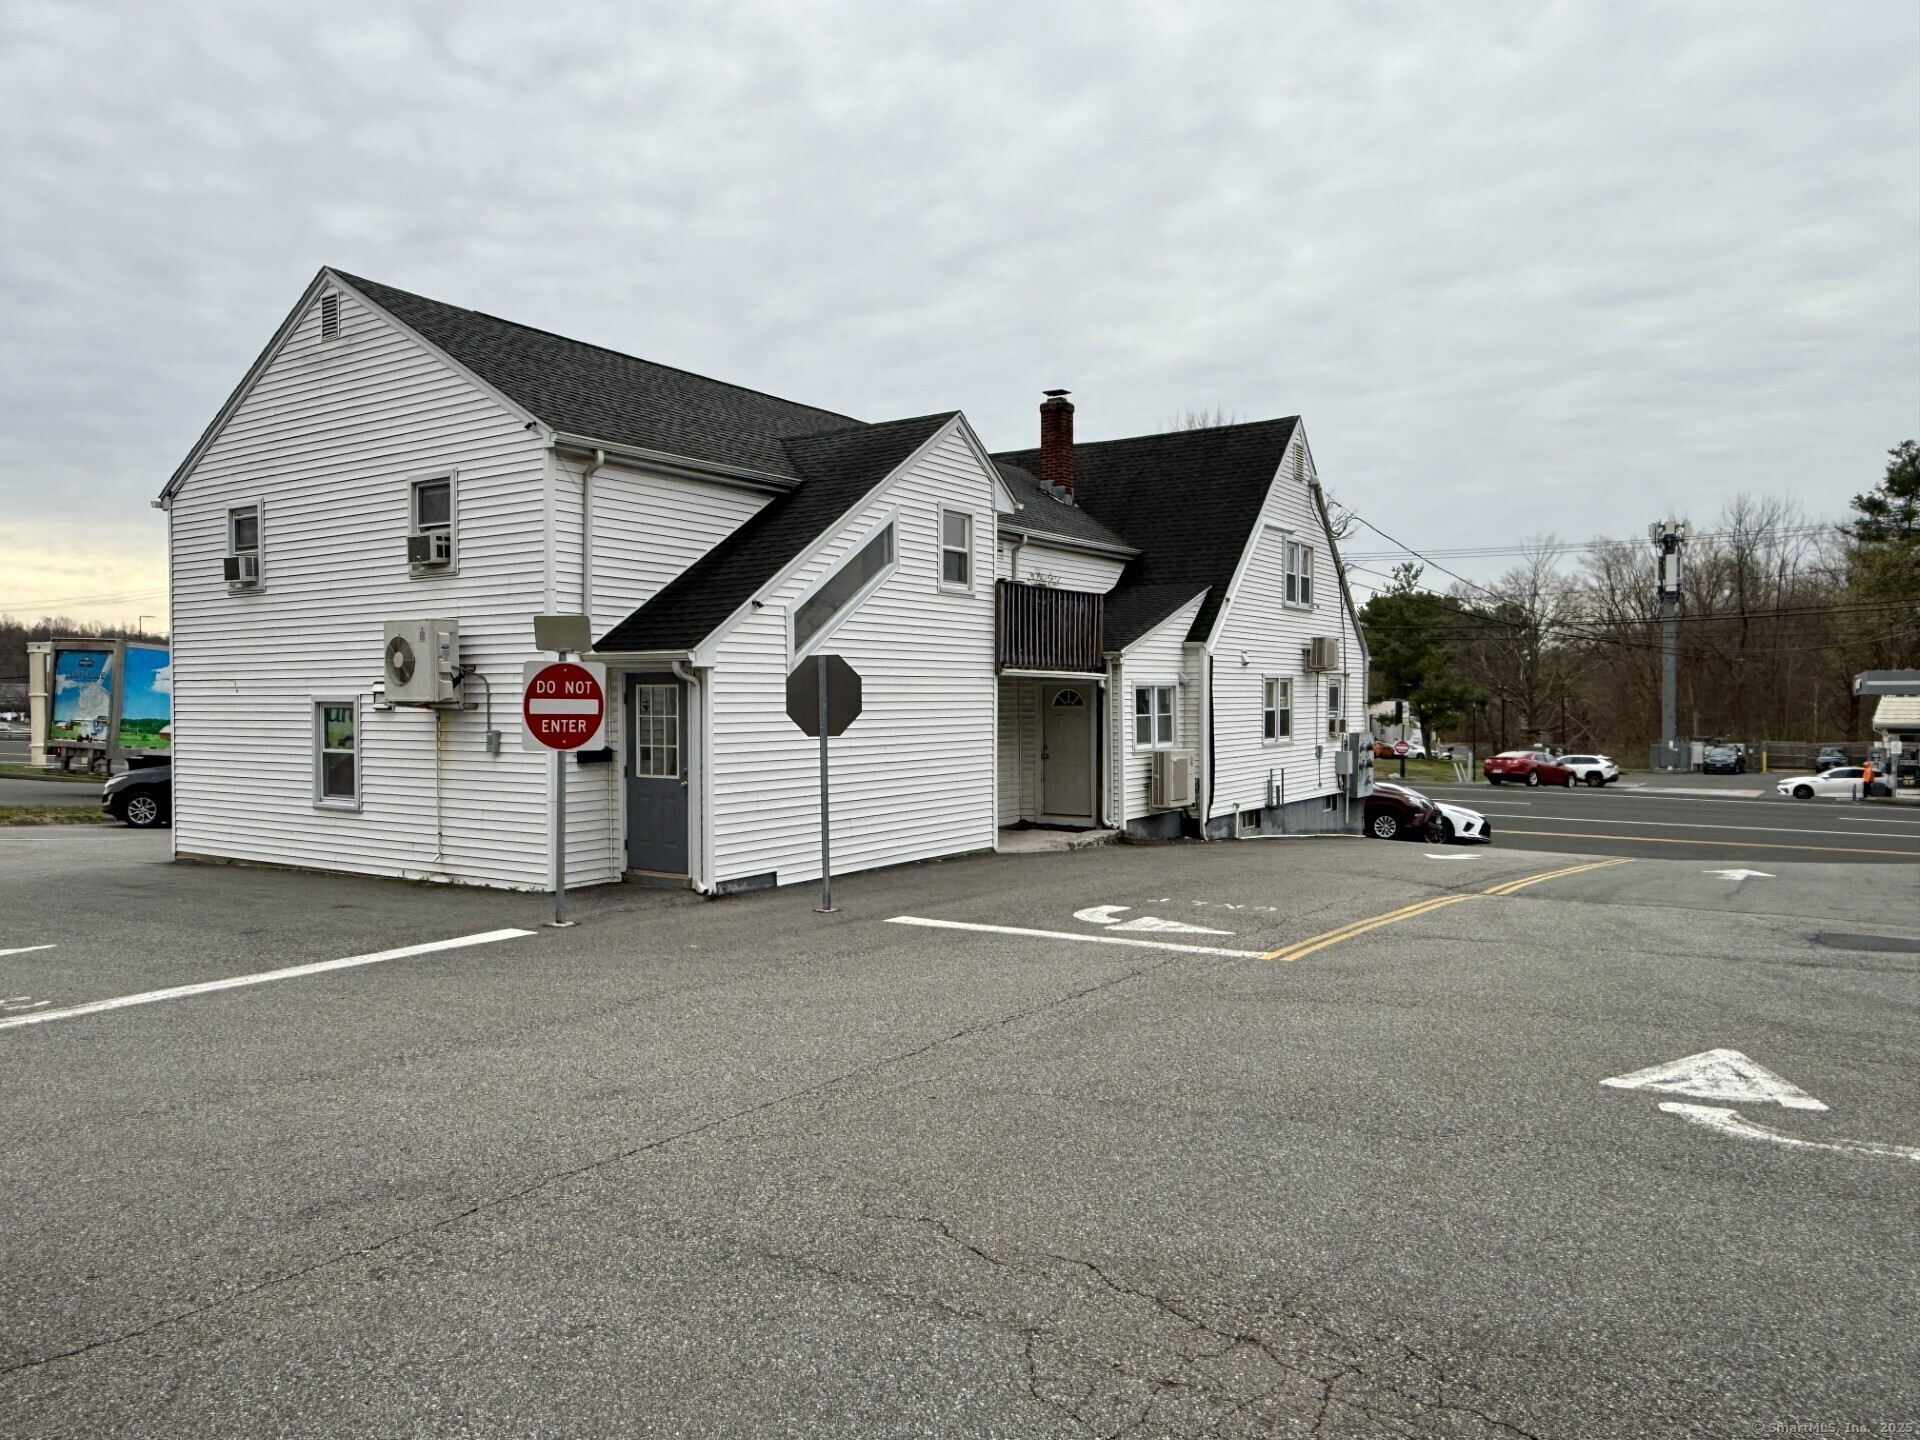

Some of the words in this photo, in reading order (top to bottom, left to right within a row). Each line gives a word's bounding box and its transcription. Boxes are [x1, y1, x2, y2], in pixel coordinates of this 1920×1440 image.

[536, 680, 556, 694] DO
[565, 680, 592, 694] NOT
[541, 719, 587, 733] ENTER
